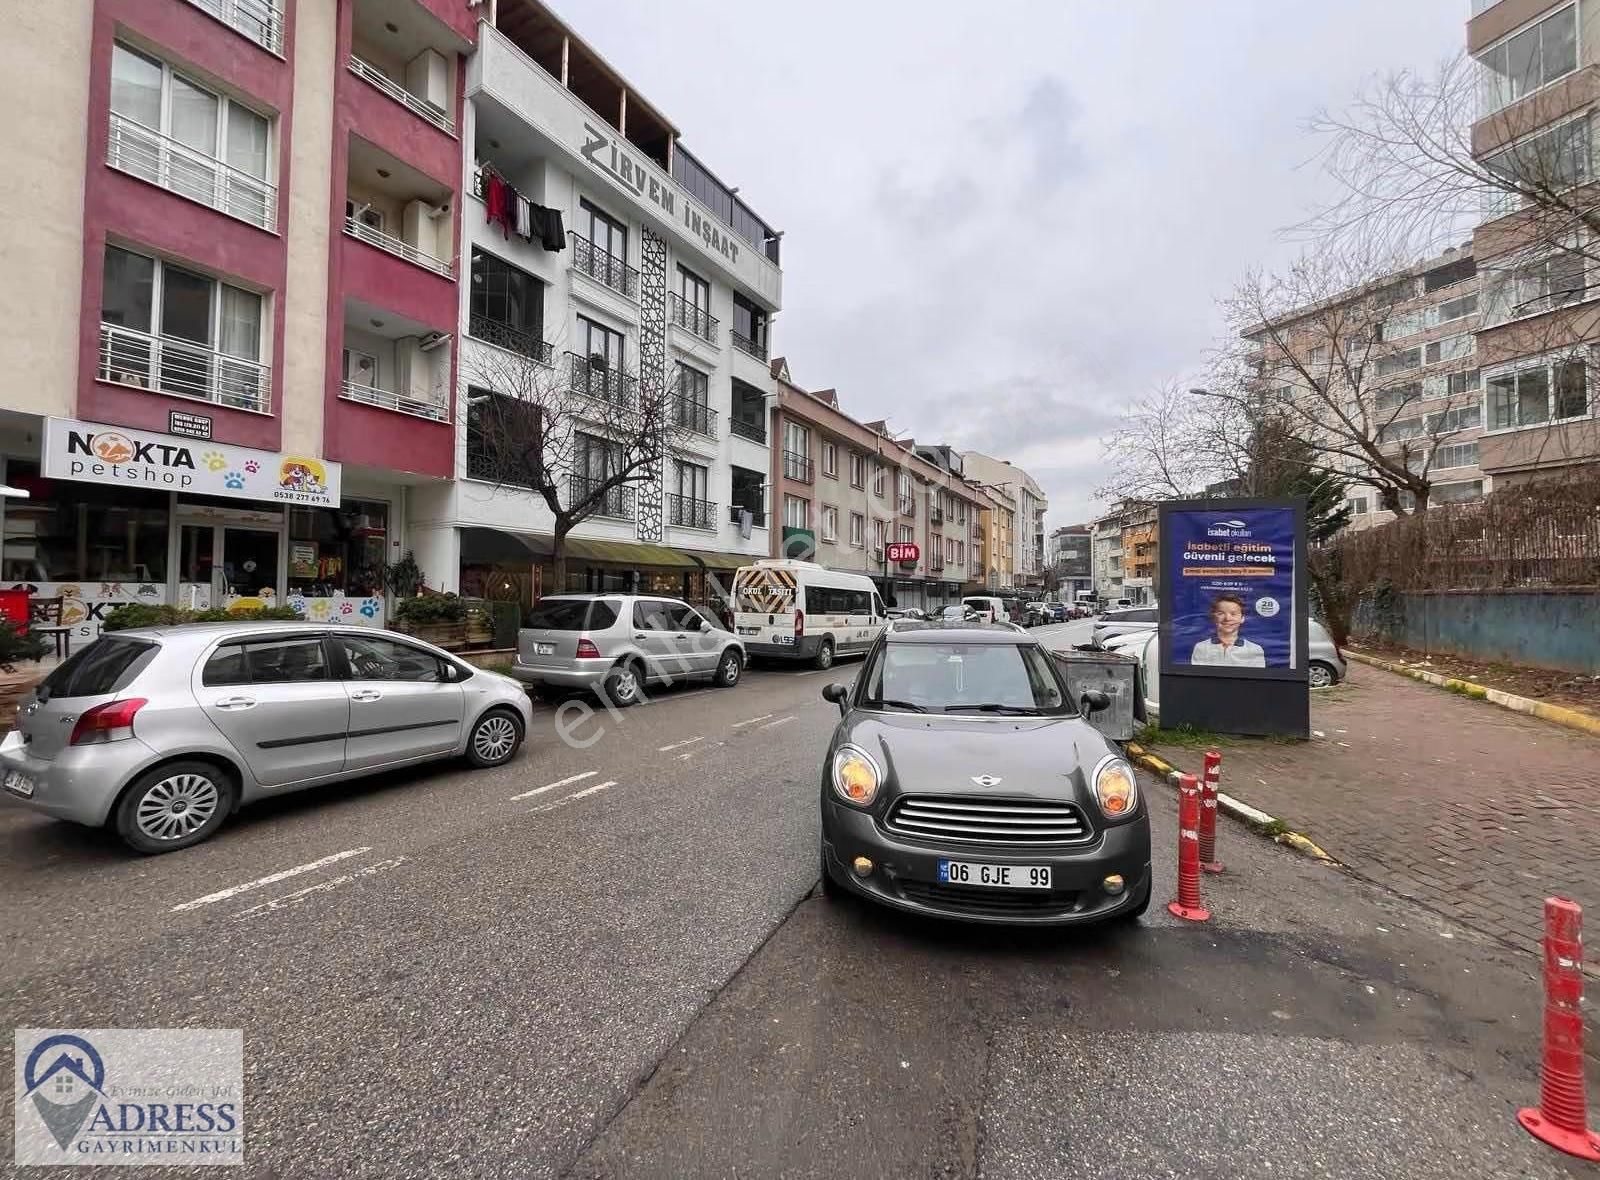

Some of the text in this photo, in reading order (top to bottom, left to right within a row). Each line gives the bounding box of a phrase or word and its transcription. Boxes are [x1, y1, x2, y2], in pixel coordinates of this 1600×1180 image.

[581, 121, 739, 264] ZİRVEM İNŞAAT
[67, 431, 196, 470] NOKTA
[70, 456, 194, 489] petshop
[273, 491, 294, 501] 0538
[889, 545, 917, 560] BİM
[1233, 542, 1272, 554] eğitim
[1183, 551, 1276, 564] Güvenli gelecek
[742, 587, 763, 596] OKUL
[949, 863, 969, 882] 06
[980, 866, 1011, 885] GJE
[1029, 867, 1049, 886] 99
